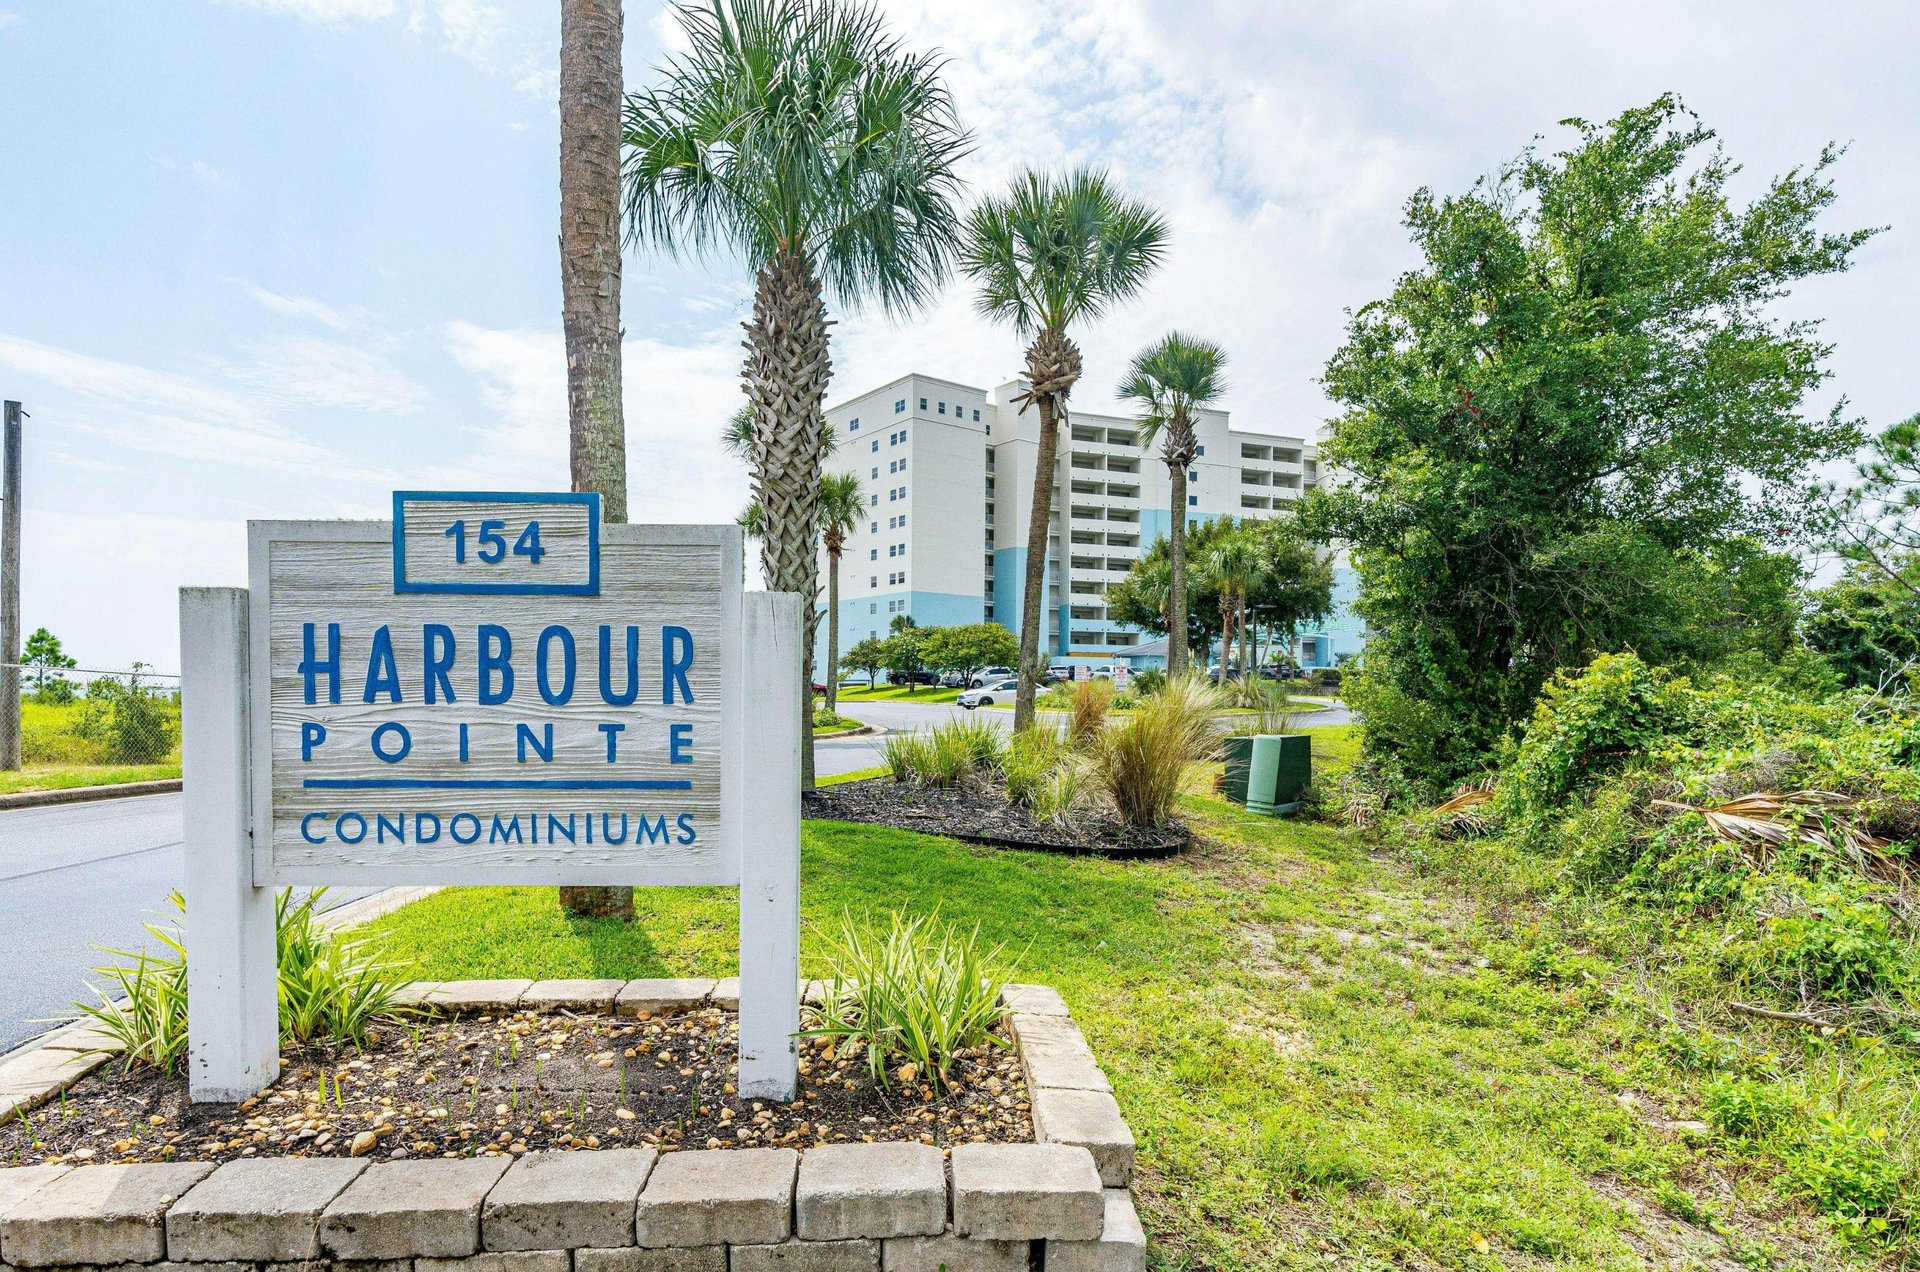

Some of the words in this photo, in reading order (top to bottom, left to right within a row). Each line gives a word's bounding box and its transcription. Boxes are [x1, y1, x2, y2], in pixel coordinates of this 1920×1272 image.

[444, 519, 546, 564] 154
[297, 622, 695, 707] HARBOUR
[301, 721, 694, 764] POINTE
[300, 811, 696, 845] CONDOMINIUMS
